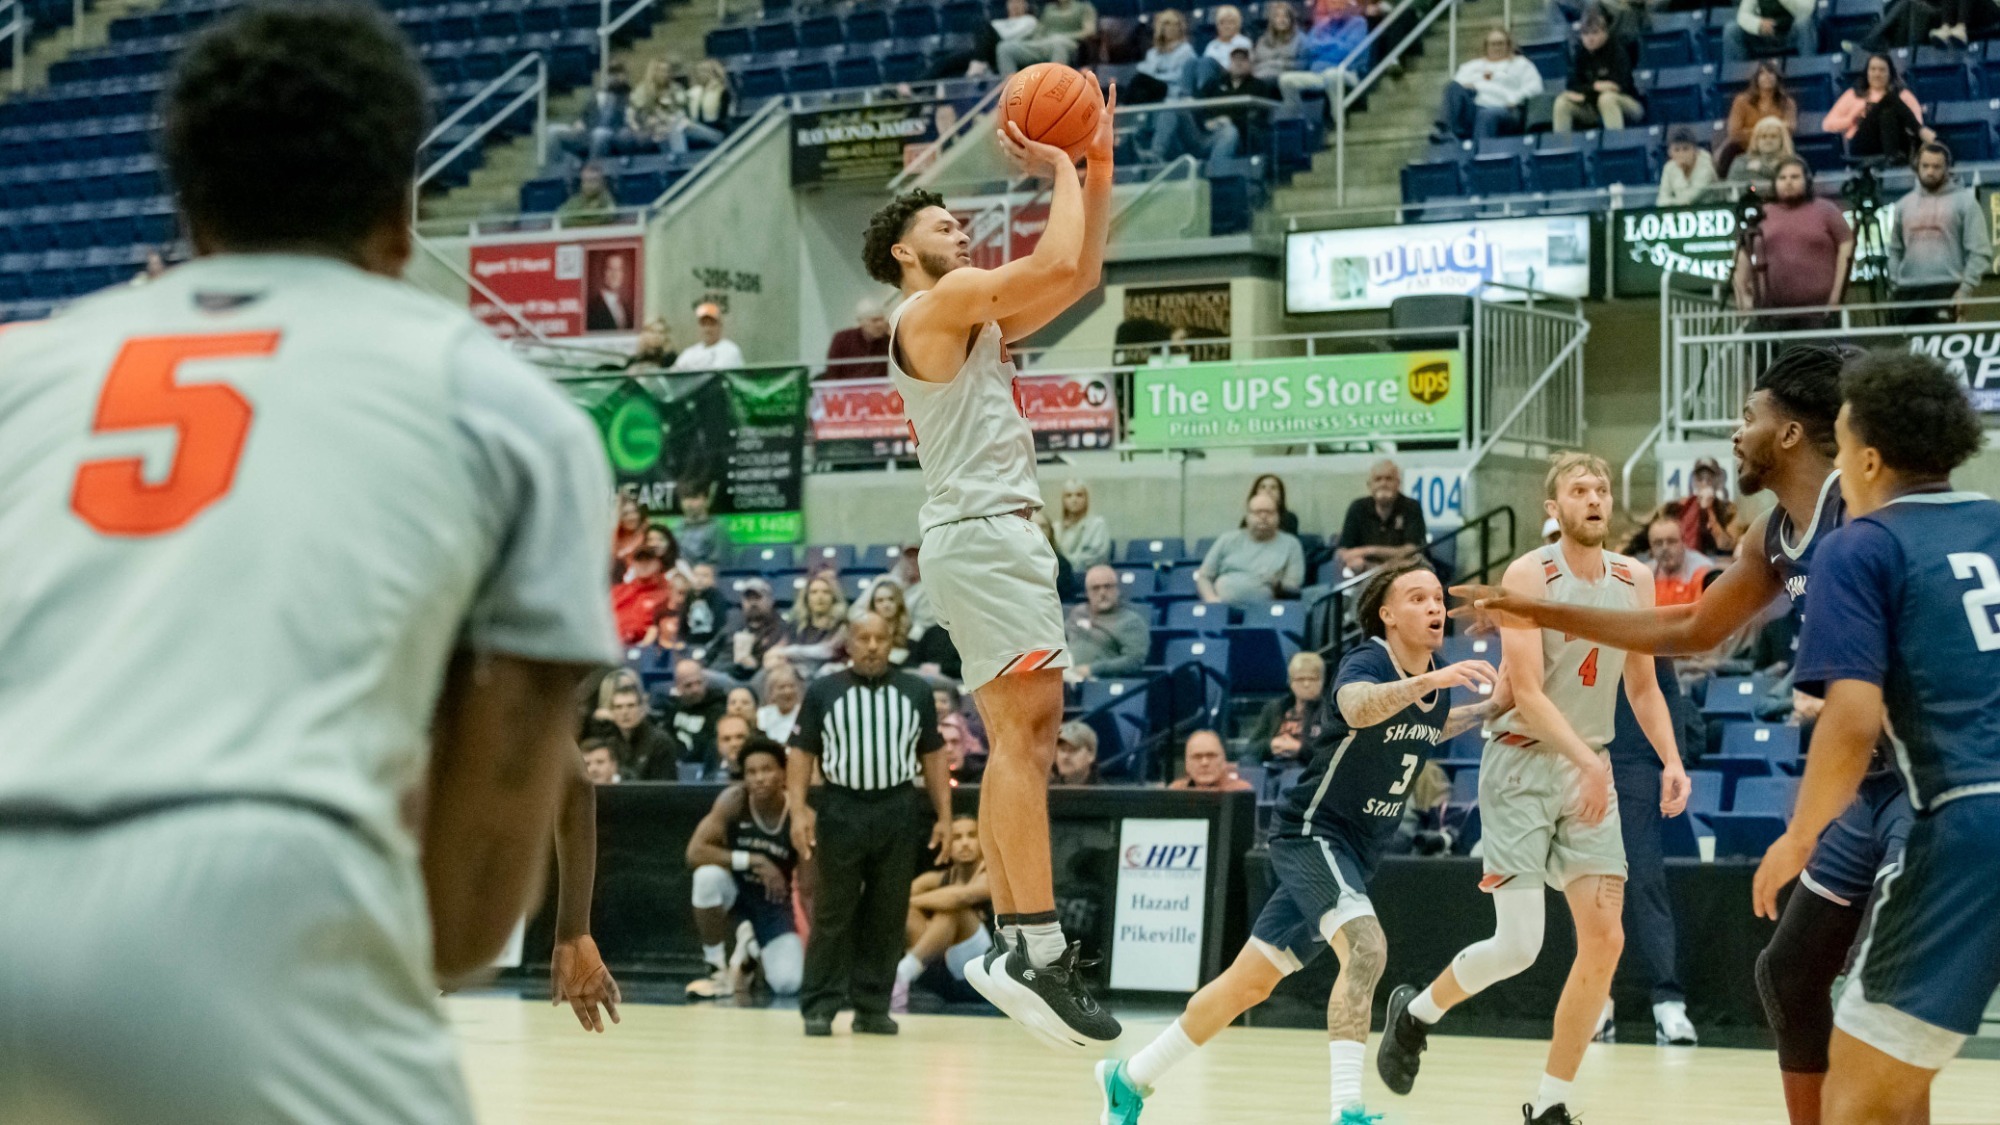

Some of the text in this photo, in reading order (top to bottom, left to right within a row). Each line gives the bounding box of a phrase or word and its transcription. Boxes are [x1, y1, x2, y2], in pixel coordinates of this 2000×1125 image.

[1623, 208, 1736, 242] LOADED
[1147, 373, 1399, 416] The UPS Store
[71, 329, 283, 538] 5
[1169, 409, 1435, 437] Print & Business Services
[1411, 475, 1462, 518] 104
[1578, 647, 1600, 687] 4
[1383, 723, 1442, 747] SHAWNE
[1388, 753, 1419, 795] 3
[1362, 798, 1403, 818] STATE
[1145, 844, 1204, 868] HPT
[1130, 894, 1190, 912] Hazard
[1119, 925, 1197, 945] Pikeville
